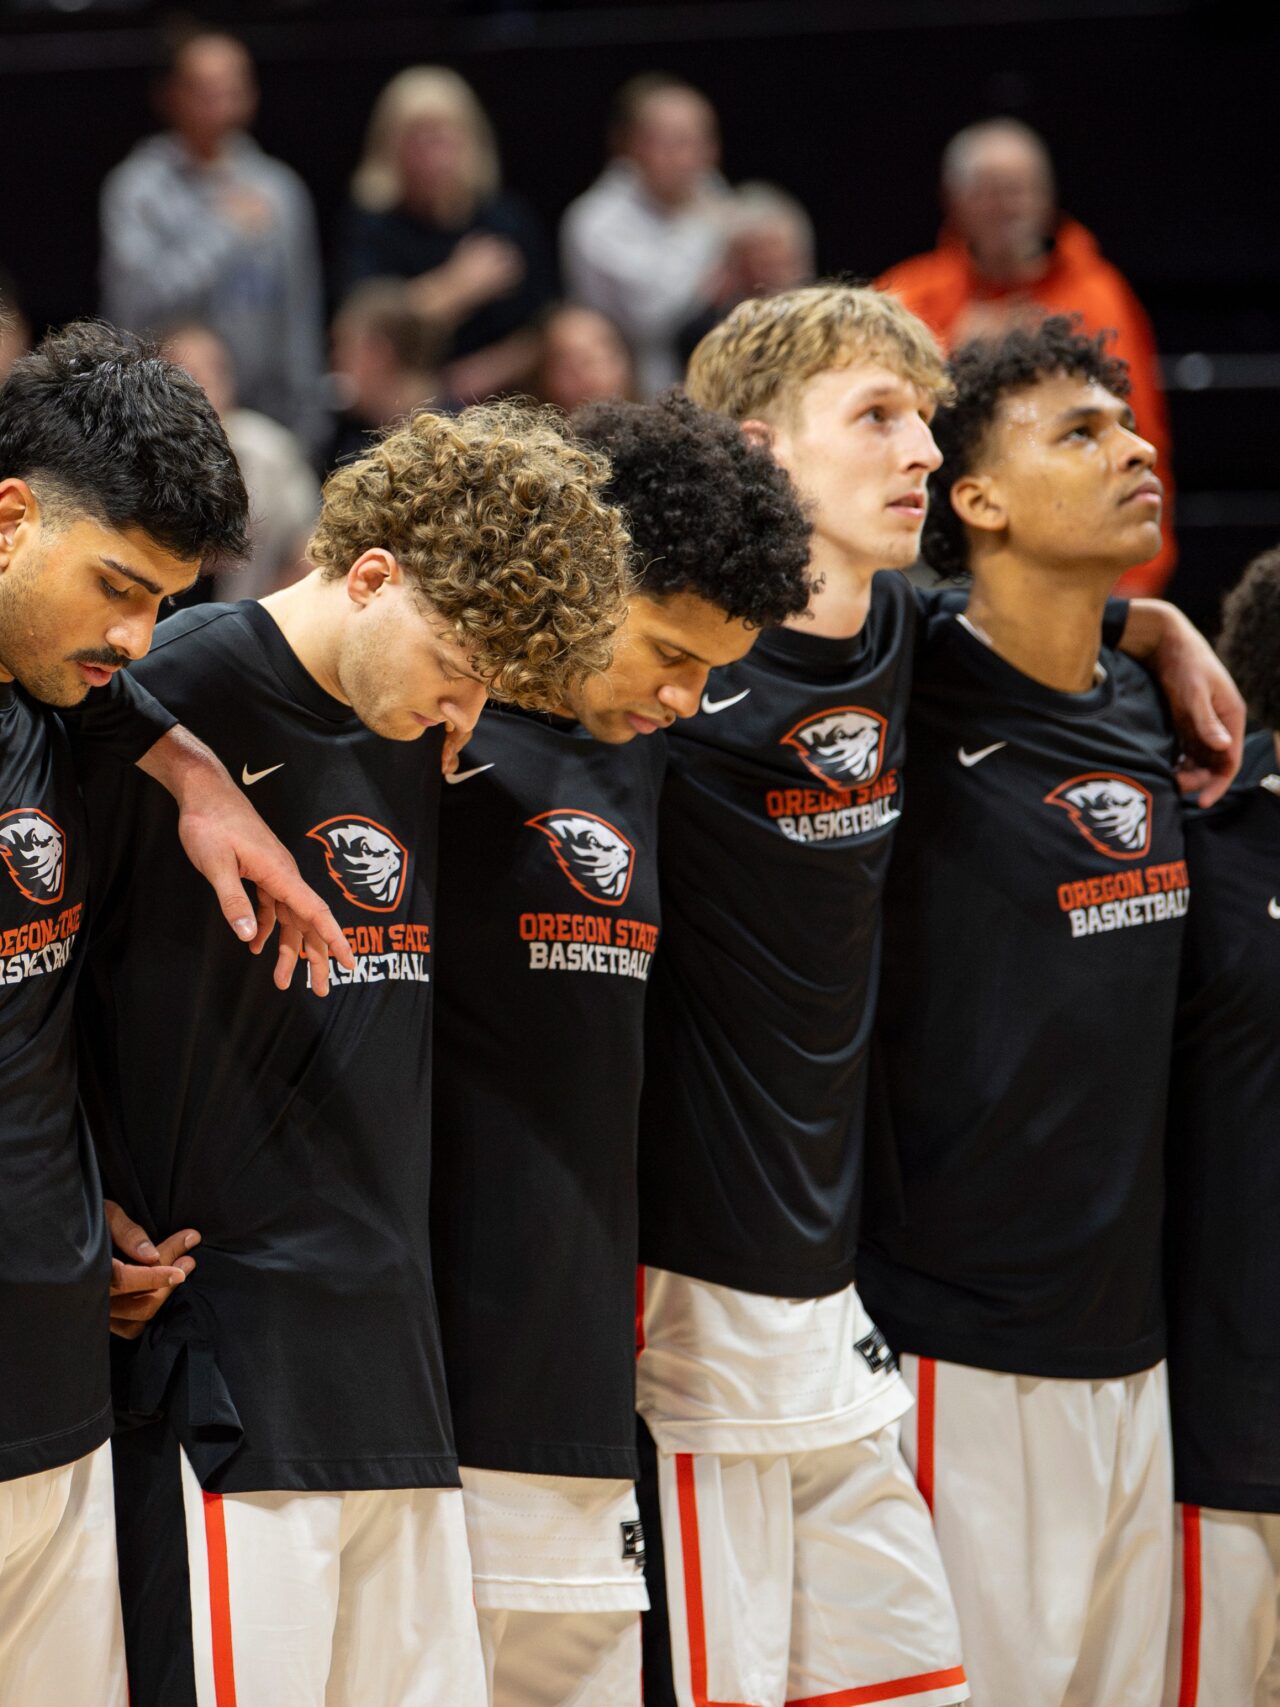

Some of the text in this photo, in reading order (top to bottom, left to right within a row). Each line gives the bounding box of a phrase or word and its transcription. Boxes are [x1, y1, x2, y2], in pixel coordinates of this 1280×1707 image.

[777, 795, 902, 843] BASKETBALL
[1057, 868, 1144, 912] OREGON
[519, 912, 660, 954] OREGON STATE
[528, 941, 652, 982] BASKETBALL
